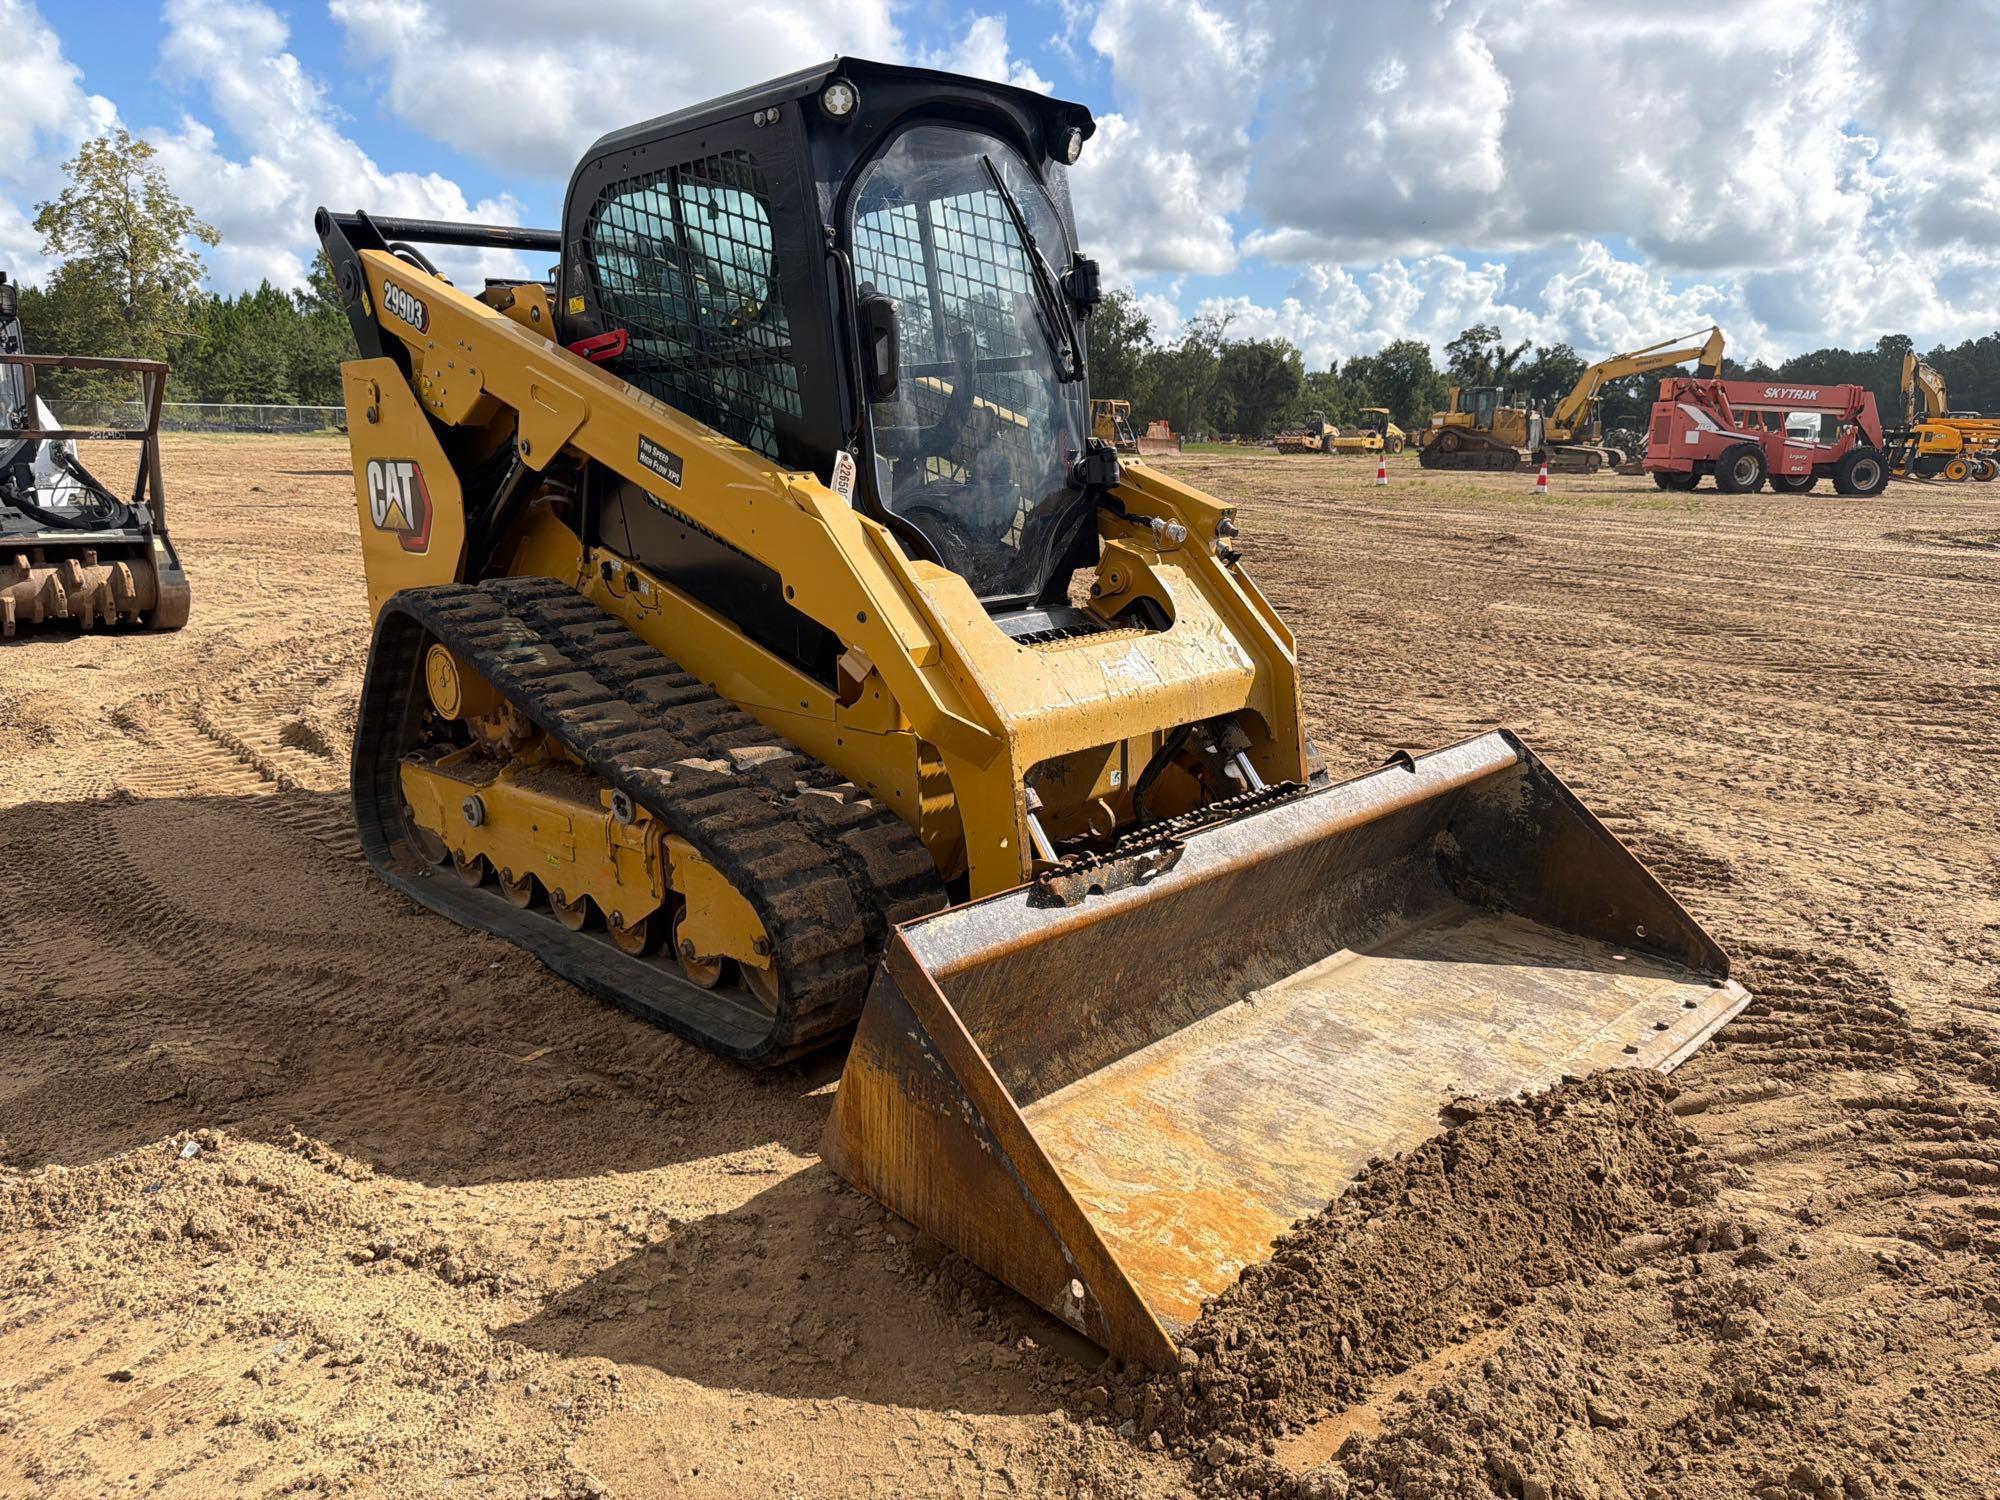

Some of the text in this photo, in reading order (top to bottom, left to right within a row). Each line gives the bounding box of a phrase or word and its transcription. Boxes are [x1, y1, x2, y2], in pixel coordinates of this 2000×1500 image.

[384, 280, 423, 330] 299D3
[1763, 387, 1820, 400] SKYTRAK
[652, 447, 669, 463] SPEED
[652, 460, 668, 475] FLOW
[667, 469, 680, 483] XPS
[367, 460, 415, 530] CAT
